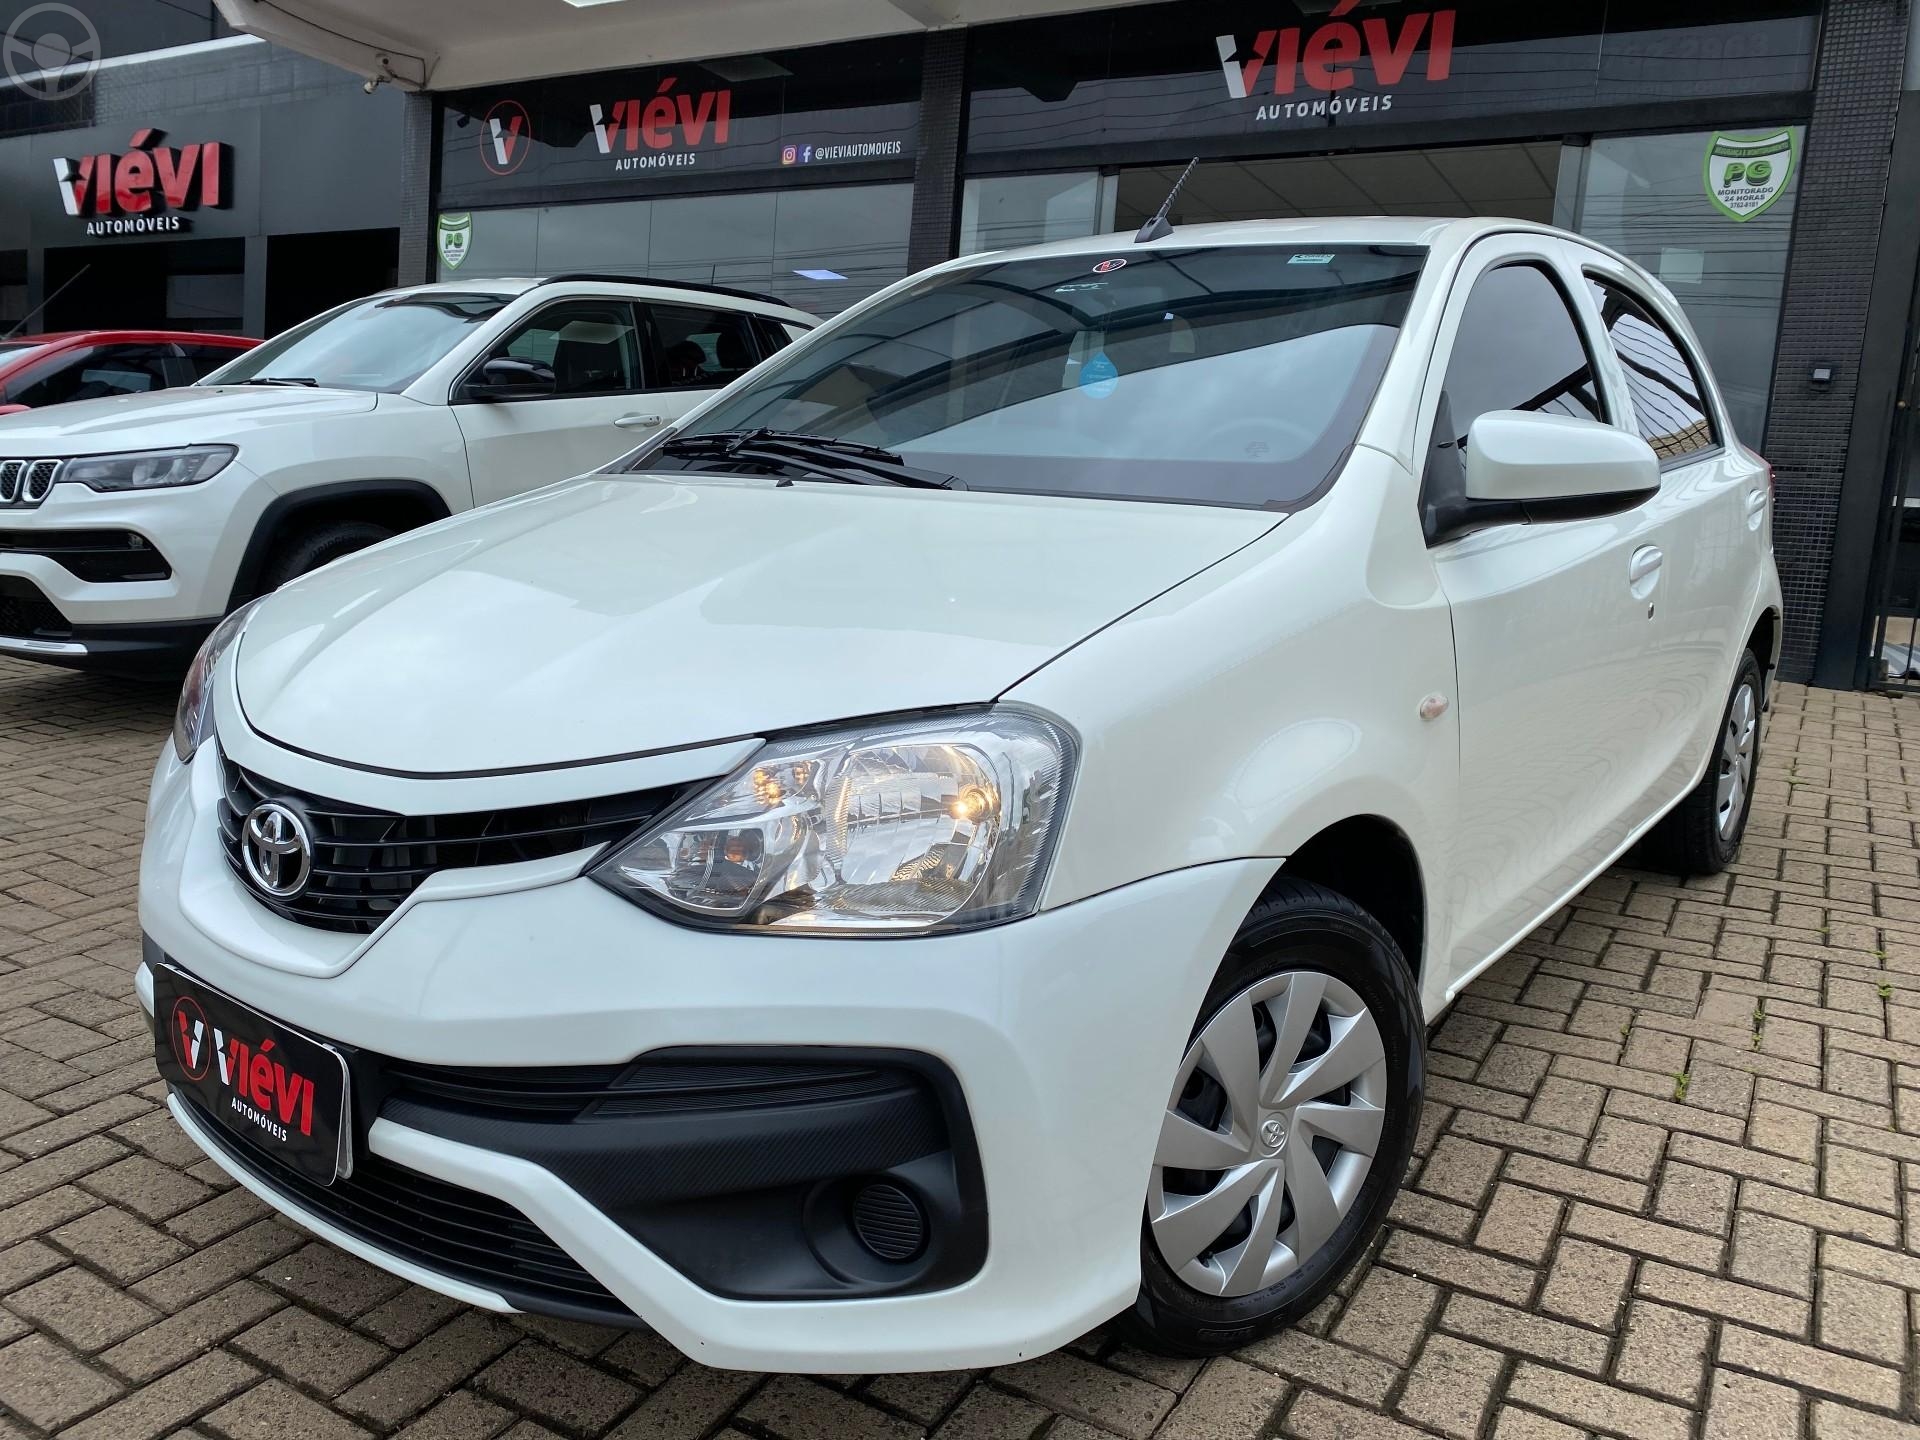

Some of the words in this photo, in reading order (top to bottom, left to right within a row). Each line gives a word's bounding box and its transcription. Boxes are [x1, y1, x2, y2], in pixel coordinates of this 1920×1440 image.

[1256, 94, 1393, 121] AUTOMÓVEIS
[615, 152, 696, 171] AUTOMÓVEIS
[815, 141, 901, 160] @VIEVIAUTOMOVEIS
[1723, 160, 1773, 188] PG
[1718, 187, 1774, 195] MONITORADO
[86, 213, 180, 236] AUTOMÓVEIS
[231, 1096, 288, 1142] AUTOMÓVEIS
